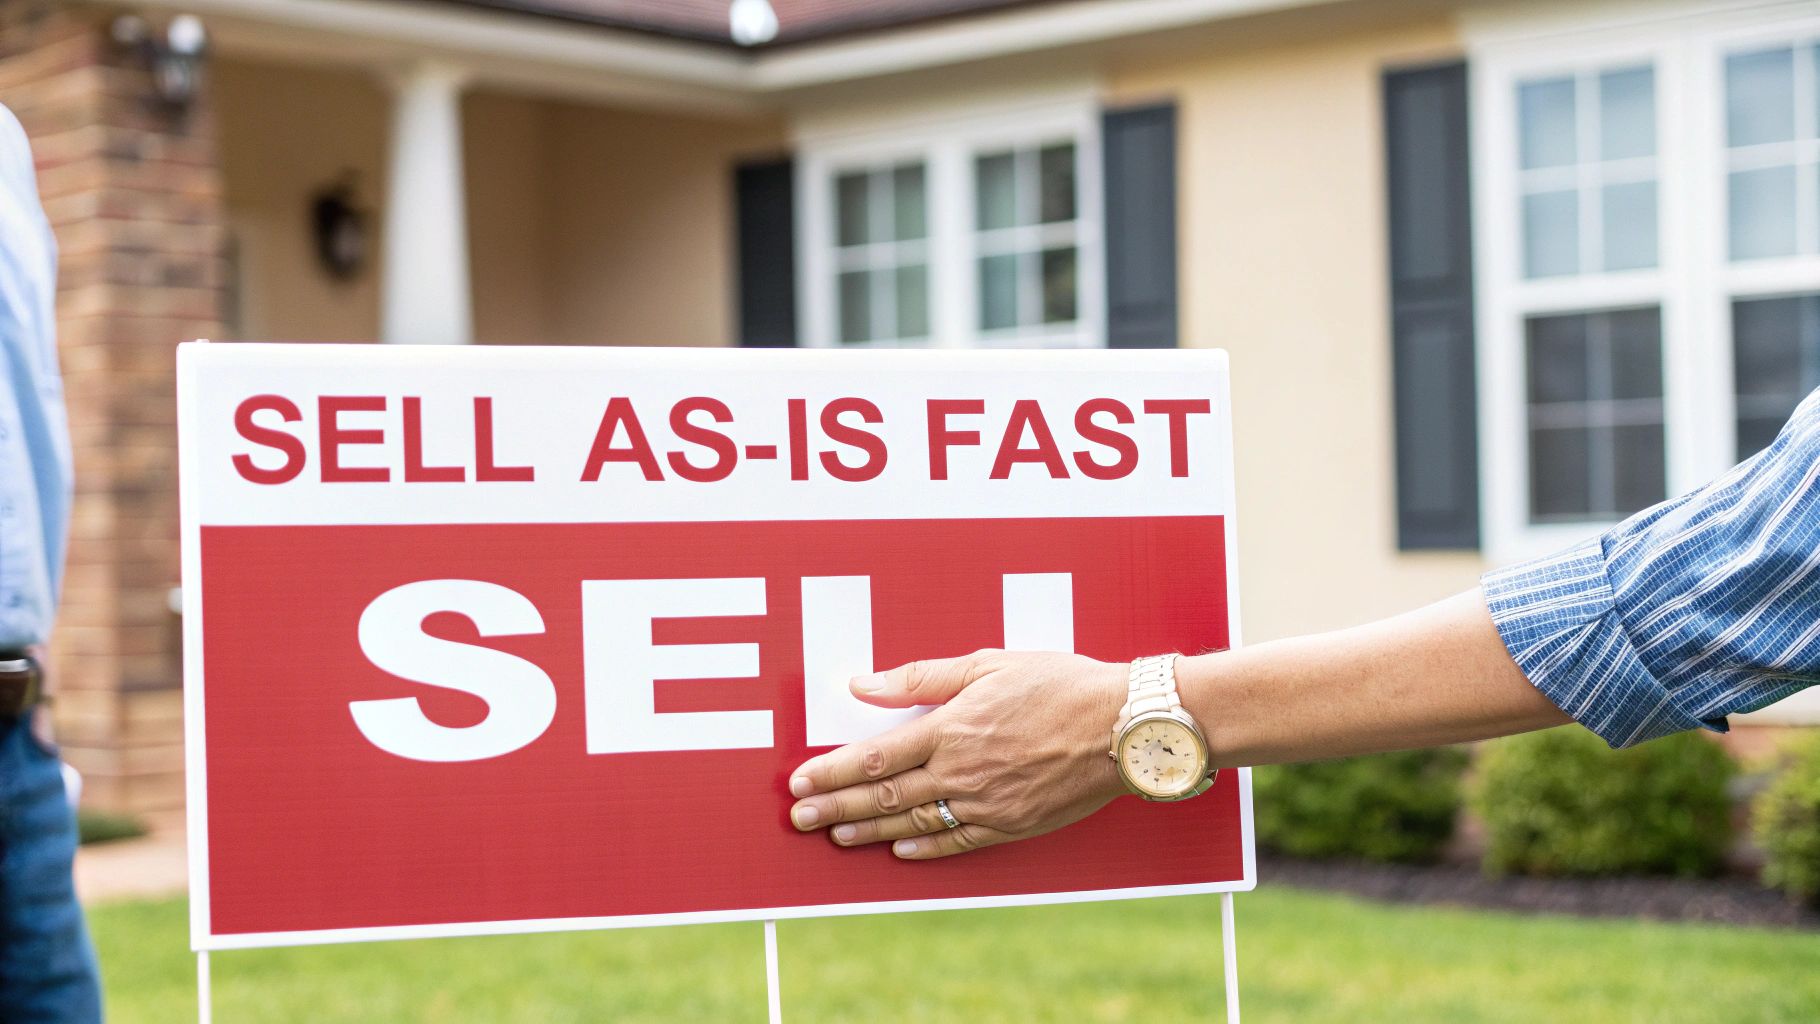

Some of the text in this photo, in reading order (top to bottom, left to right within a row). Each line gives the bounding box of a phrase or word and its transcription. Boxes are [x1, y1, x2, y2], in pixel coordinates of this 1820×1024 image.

[231, 394, 1212, 486] SELL AS-IS FAST
